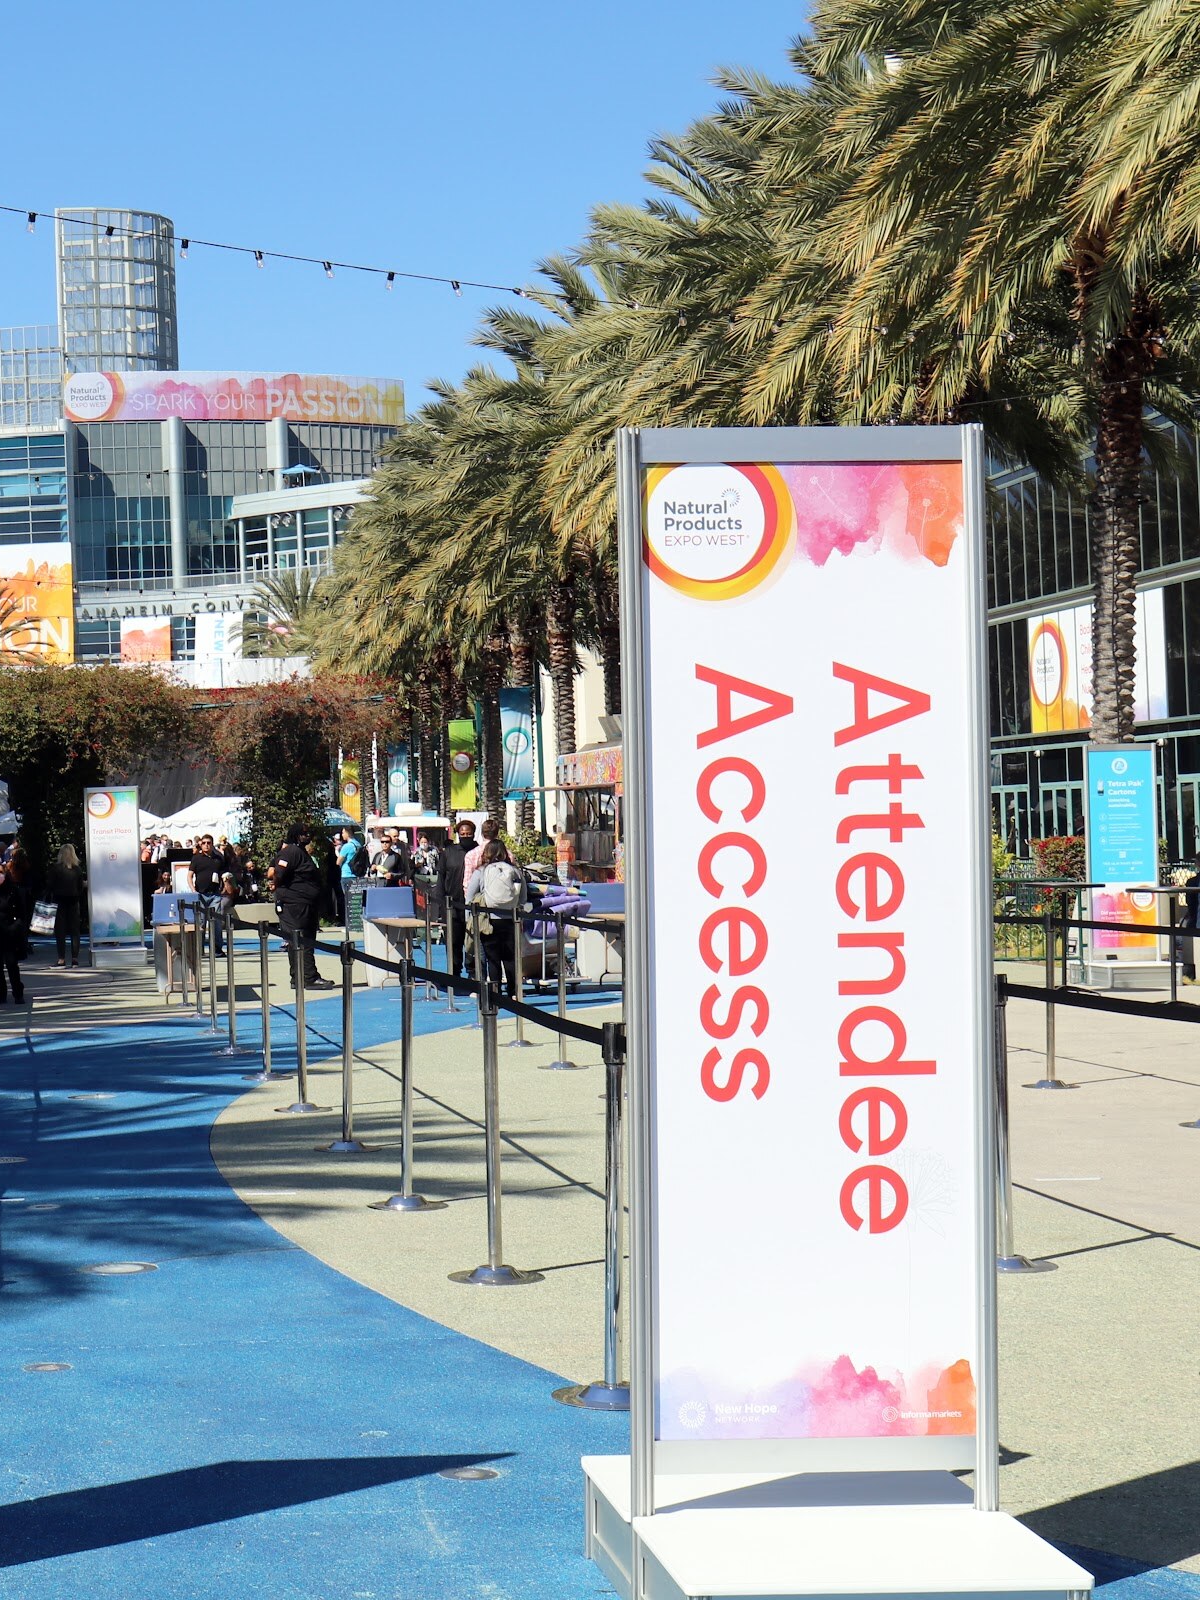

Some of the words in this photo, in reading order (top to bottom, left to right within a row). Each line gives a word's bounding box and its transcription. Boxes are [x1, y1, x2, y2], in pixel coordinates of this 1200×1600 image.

[132, 393, 196, 412] SPARK
[202, 393, 256, 411] YOUR
[266, 389, 384, 419] PASSION
[664, 500, 728, 515] Natural
[664, 516, 743, 531] Products
[664, 535, 702, 546] EXPO
[706, 534, 744, 546] WEST
[81, 603, 174, 621] ANAHEIM
[695, 664, 794, 1103] Access
[833, 661, 936, 1234] Attendee
[715, 1403, 742, 1414] New
[745, 1403, 777, 1416] Hope
[715, 1416, 760, 1424] NETWORK
